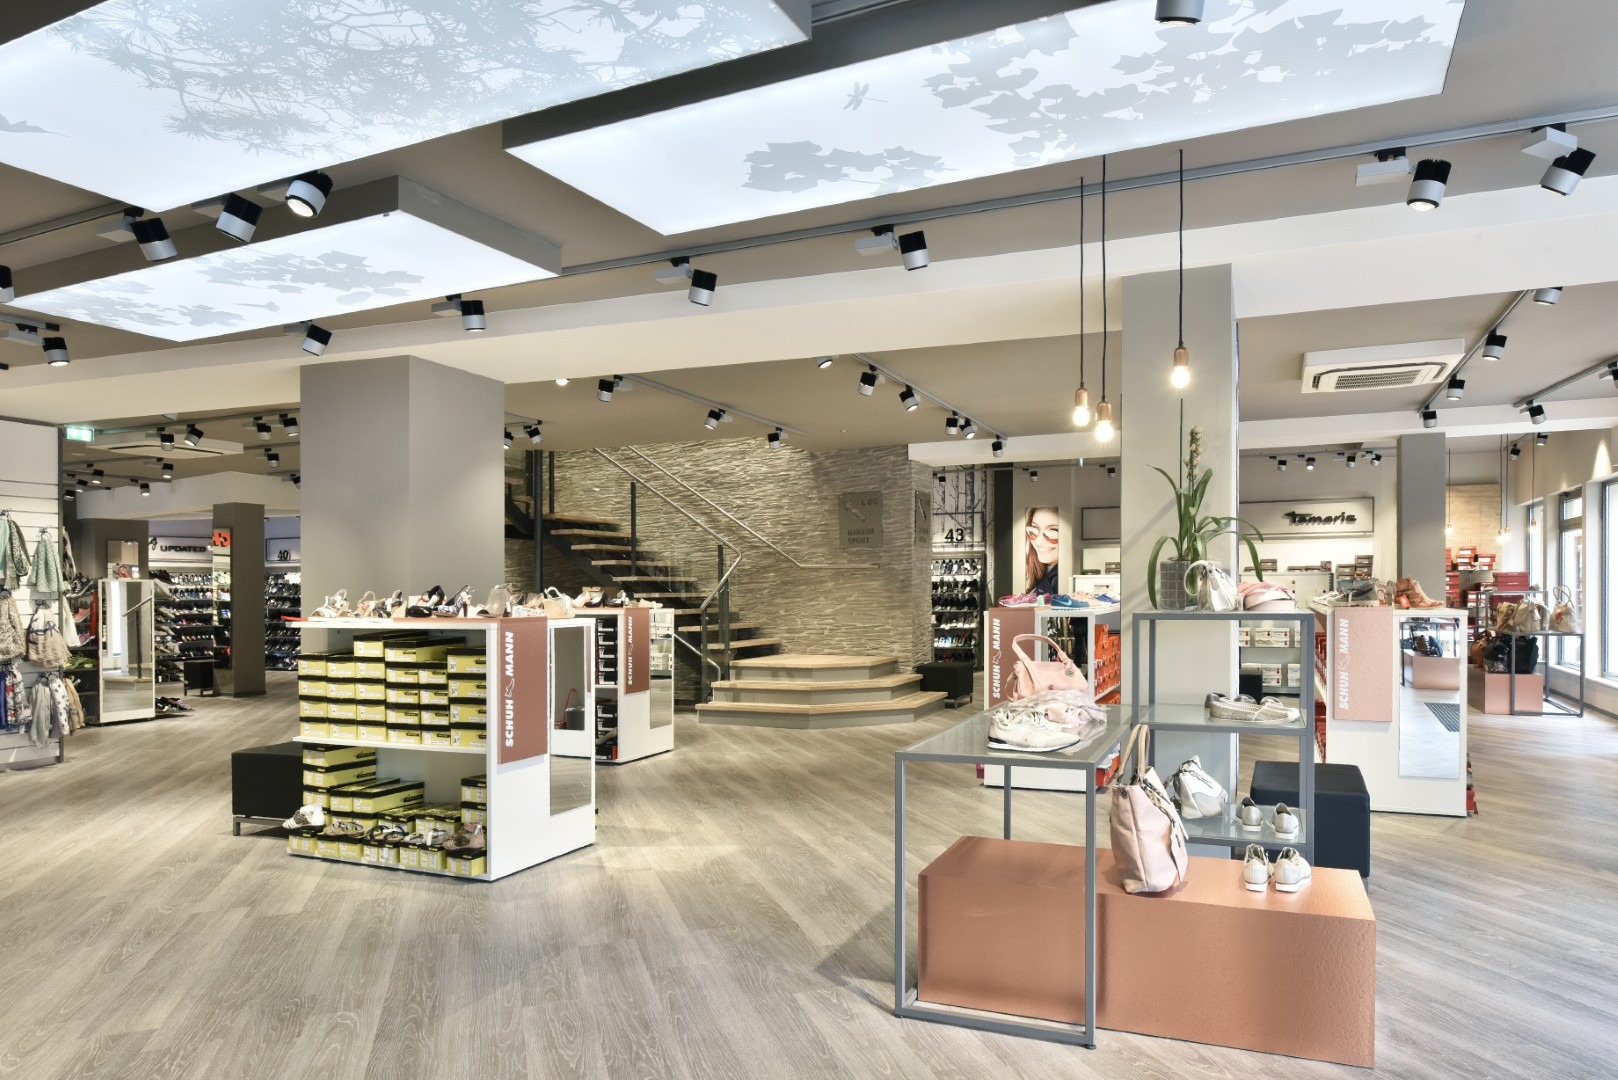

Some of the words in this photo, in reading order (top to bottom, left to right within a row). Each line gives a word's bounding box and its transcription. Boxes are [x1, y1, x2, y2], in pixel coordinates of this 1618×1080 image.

[944, 528, 964, 542] 43
[277, 549, 289, 561] 40
[993, 618, 1001, 651] MANN
[1339, 618, 1349, 654] MANN
[505, 631, 514, 677] MANN
[993, 664, 1001, 699] SCHUH
[1339, 671, 1349, 710] SCHUH
[505, 699, 514, 748] SCHUH
